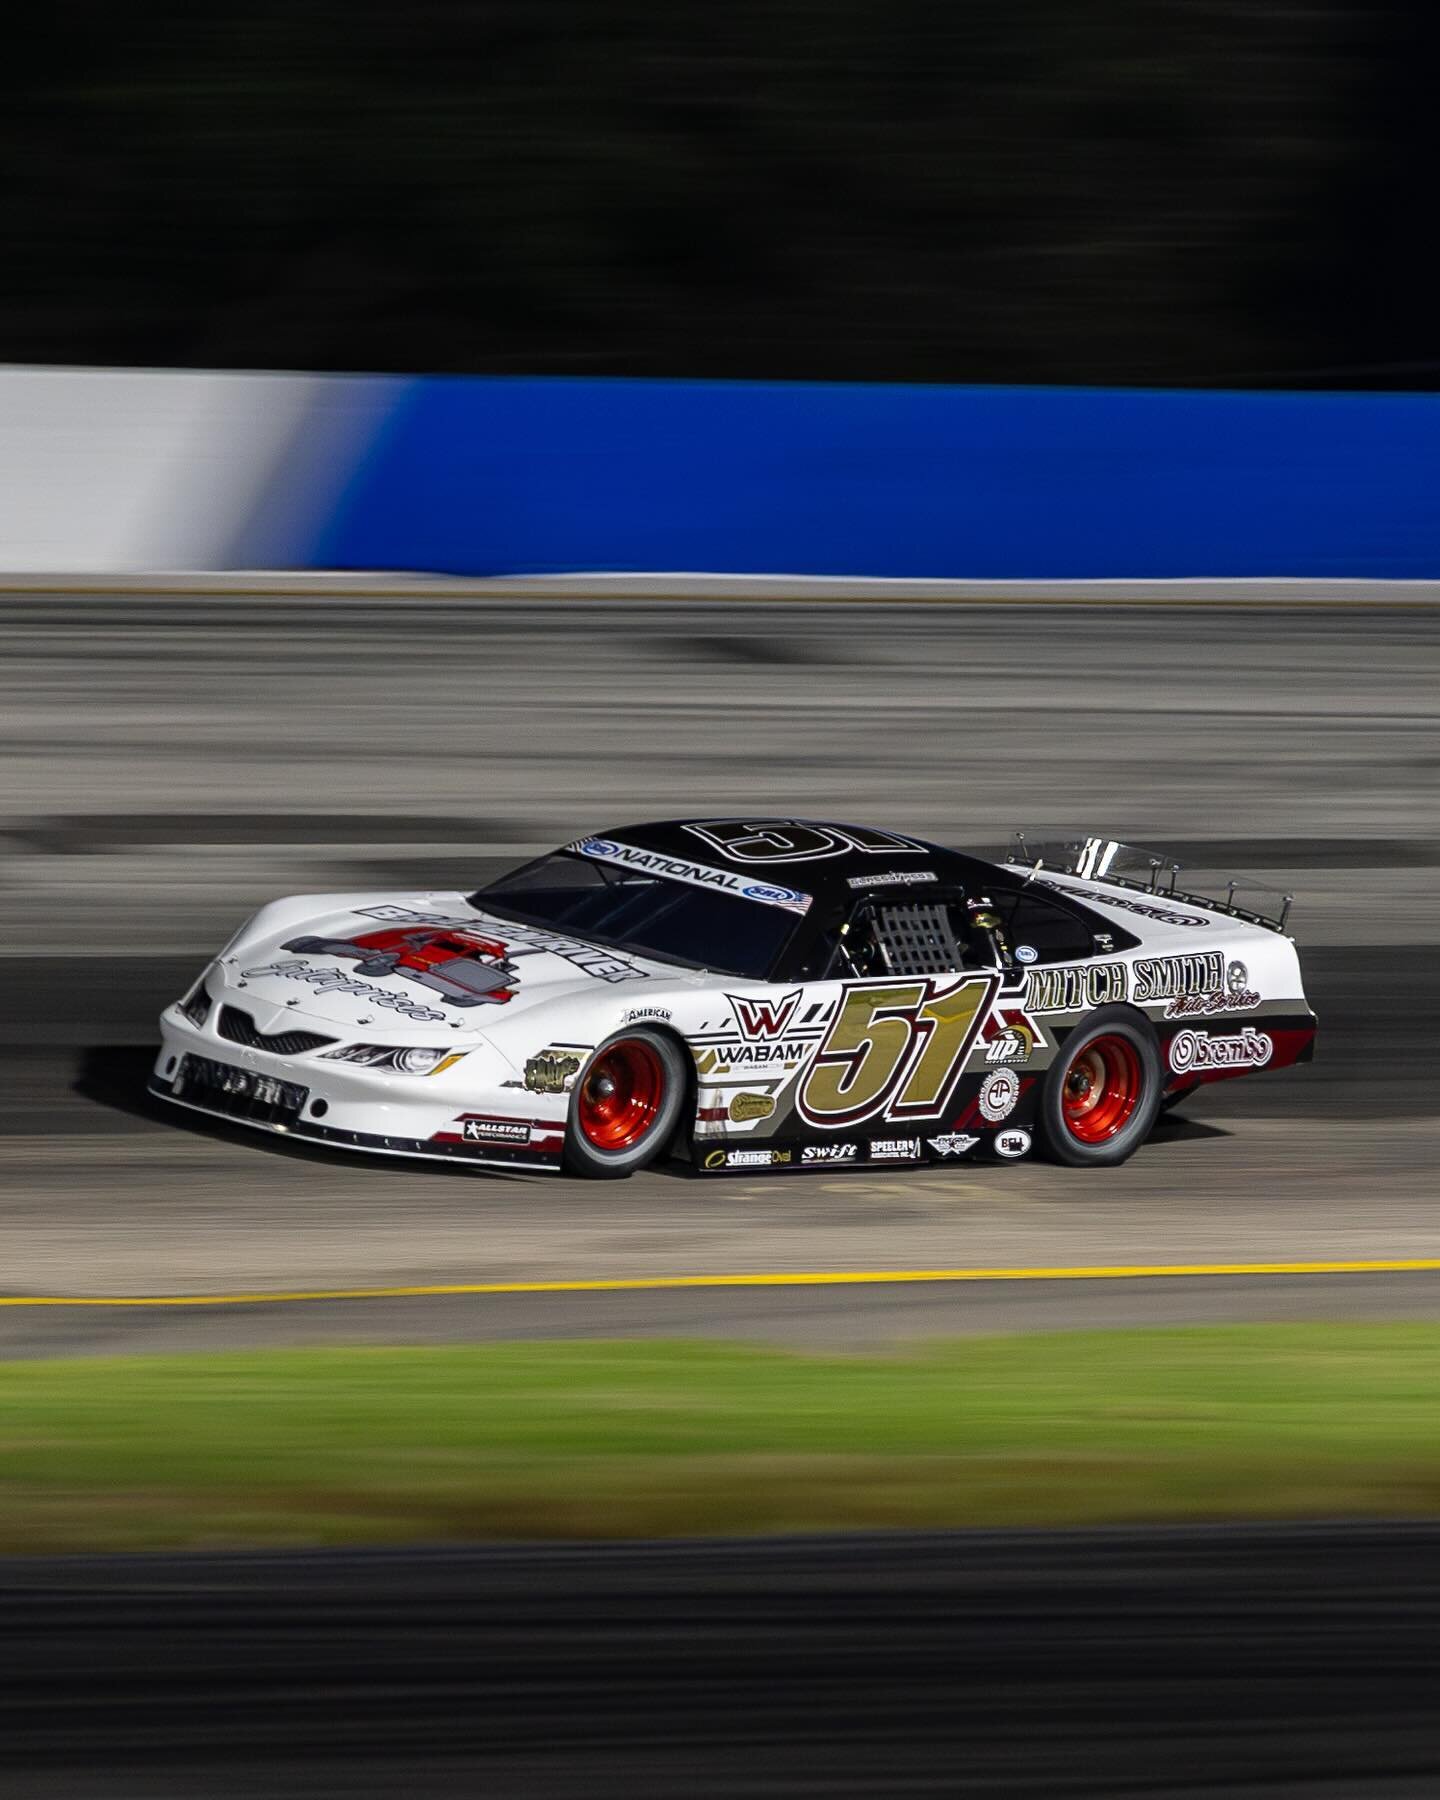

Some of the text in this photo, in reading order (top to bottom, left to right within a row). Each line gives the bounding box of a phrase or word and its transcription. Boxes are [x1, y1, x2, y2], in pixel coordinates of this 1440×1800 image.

[681, 818, 930, 863] 51
[613, 847, 743, 891] NATIONAL
[1026, 952, 1224, 1011] MITCH SMITH
[717, 1044, 803, 1063] WABAM
[797, 976, 1001, 1128] 51
[986, 1039, 1019, 1060] UP
[478, 1124, 528, 1134] ALLSTAR
[870, 1141, 908, 1152] SPEELER
